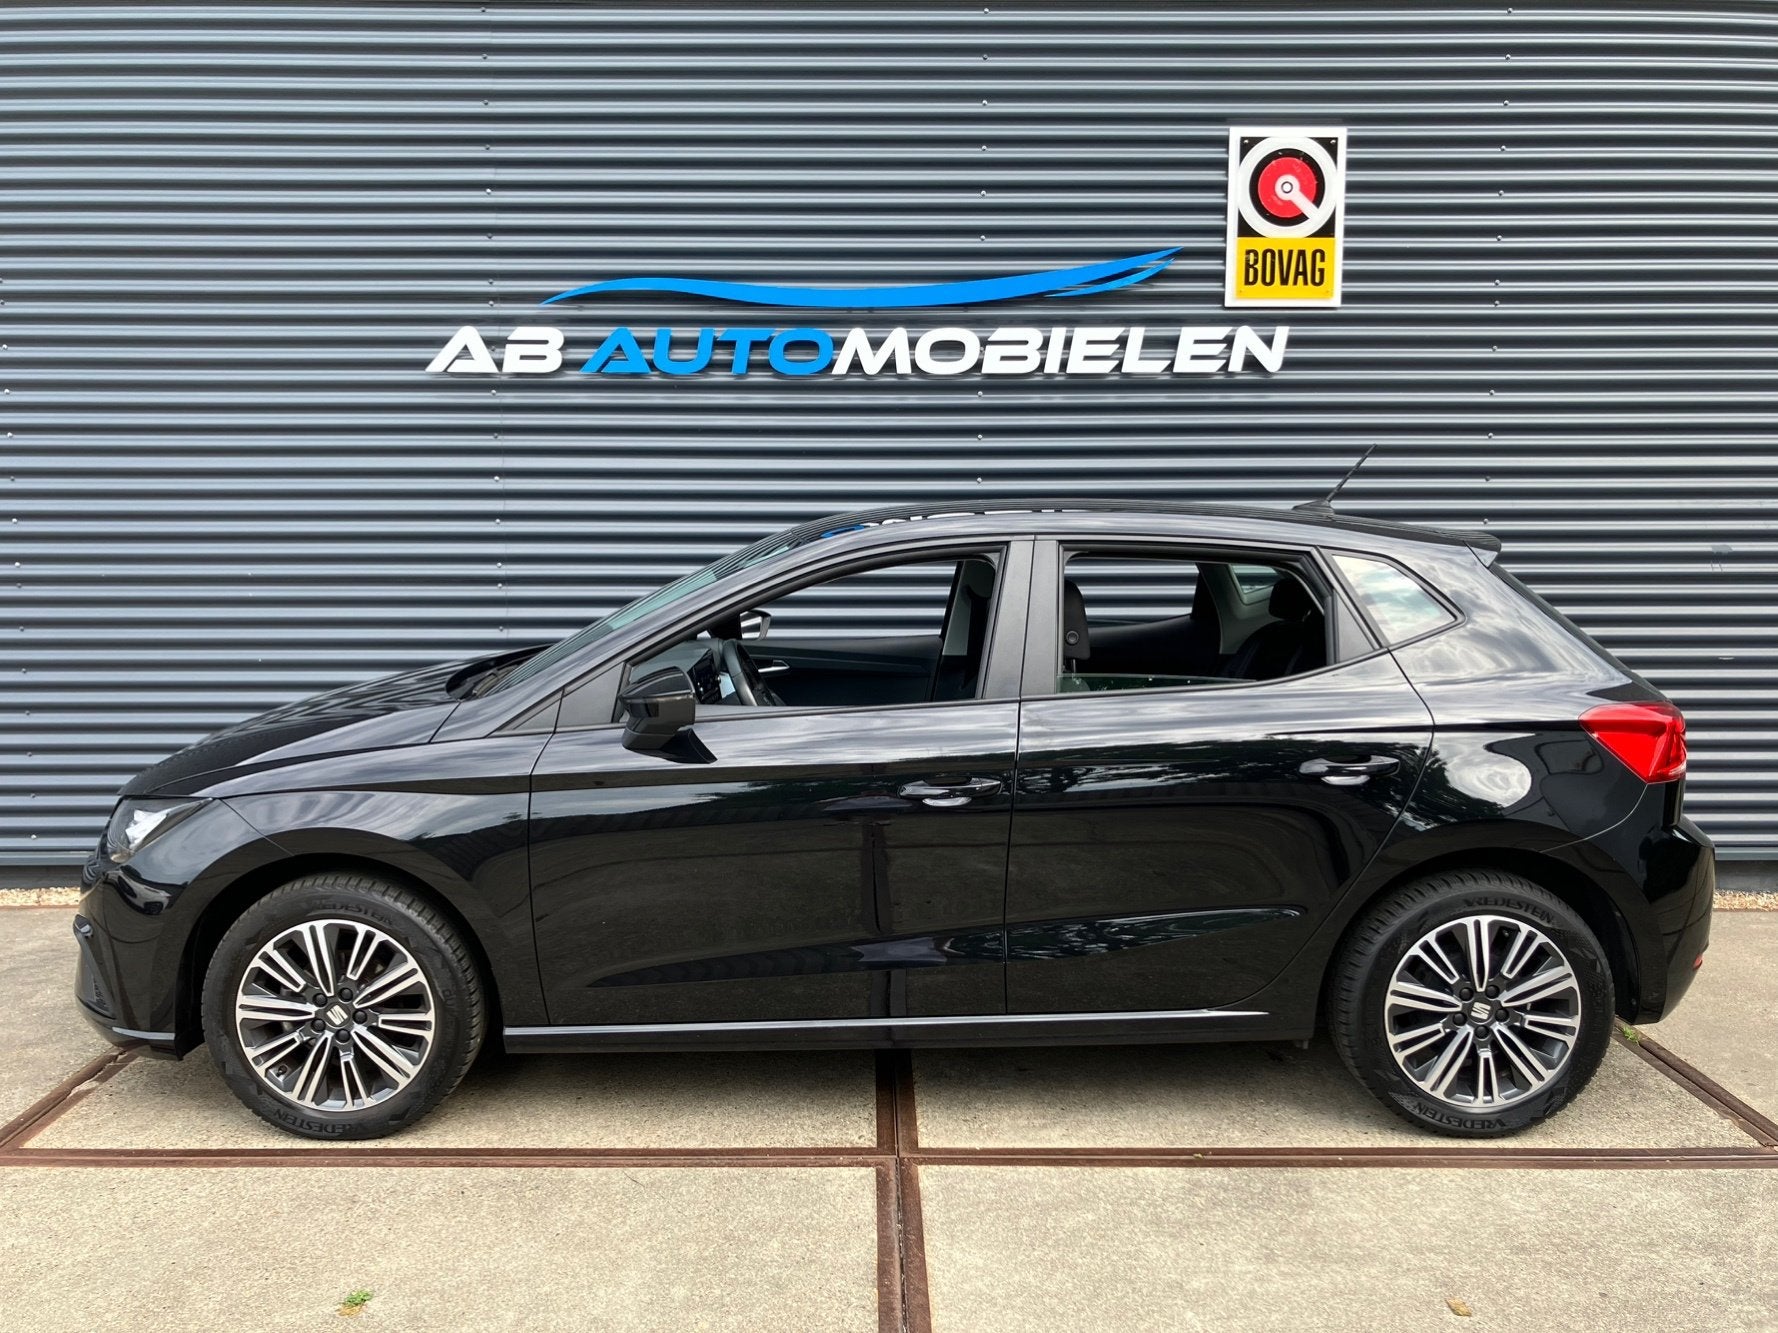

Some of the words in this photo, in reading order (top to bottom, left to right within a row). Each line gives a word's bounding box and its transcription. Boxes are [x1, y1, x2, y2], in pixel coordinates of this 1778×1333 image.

[1244, 248, 1326, 287] BOVAG
[425, 325, 564, 373] AB
[579, 325, 1290, 375] AUTOMOBIELEN
[312, 900, 394, 926] EDESTEIN
[1463, 896, 1555, 924] VREDESTEIN
[1413, 1102, 1506, 1130] VREDESTEIN
